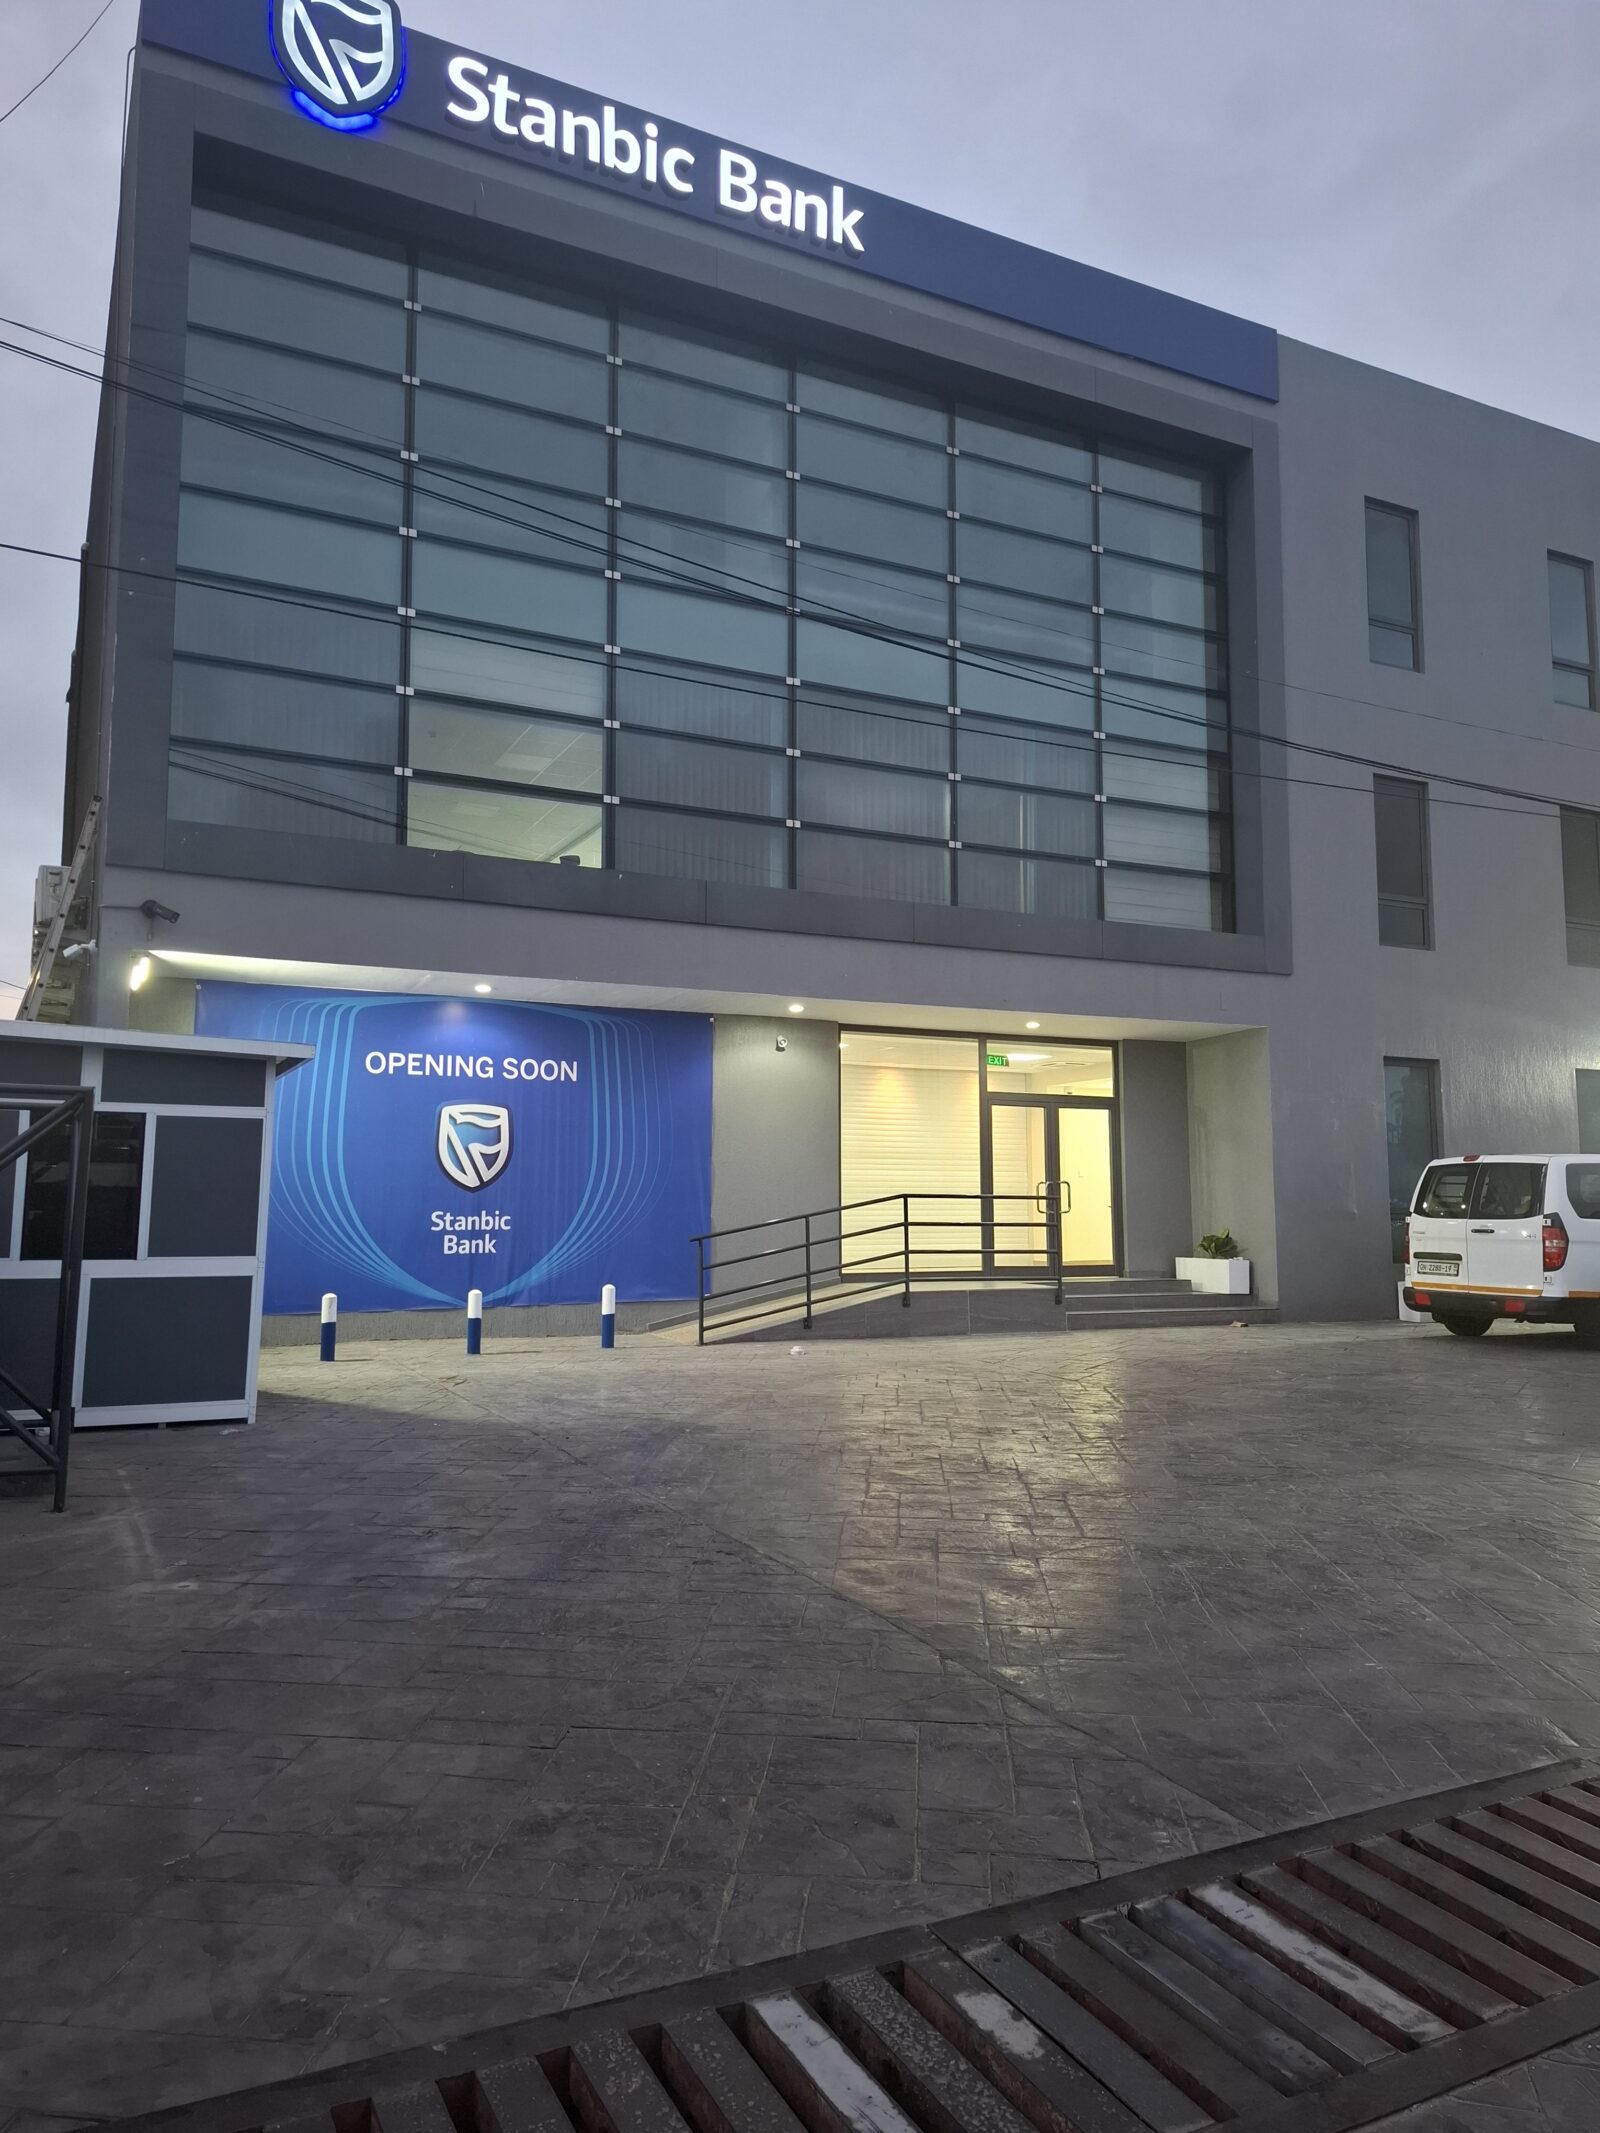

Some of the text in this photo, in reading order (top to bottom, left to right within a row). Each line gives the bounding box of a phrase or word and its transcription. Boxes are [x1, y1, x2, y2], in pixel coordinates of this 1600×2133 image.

[447, 57, 865, 252] Stanbic Bank
[365, 1051, 578, 1082] OPENING SOON
[988, 1055, 1007, 1066] EXIT
[430, 1210, 511, 1231] Stanbic
[443, 1234, 497, 1255] Bank
